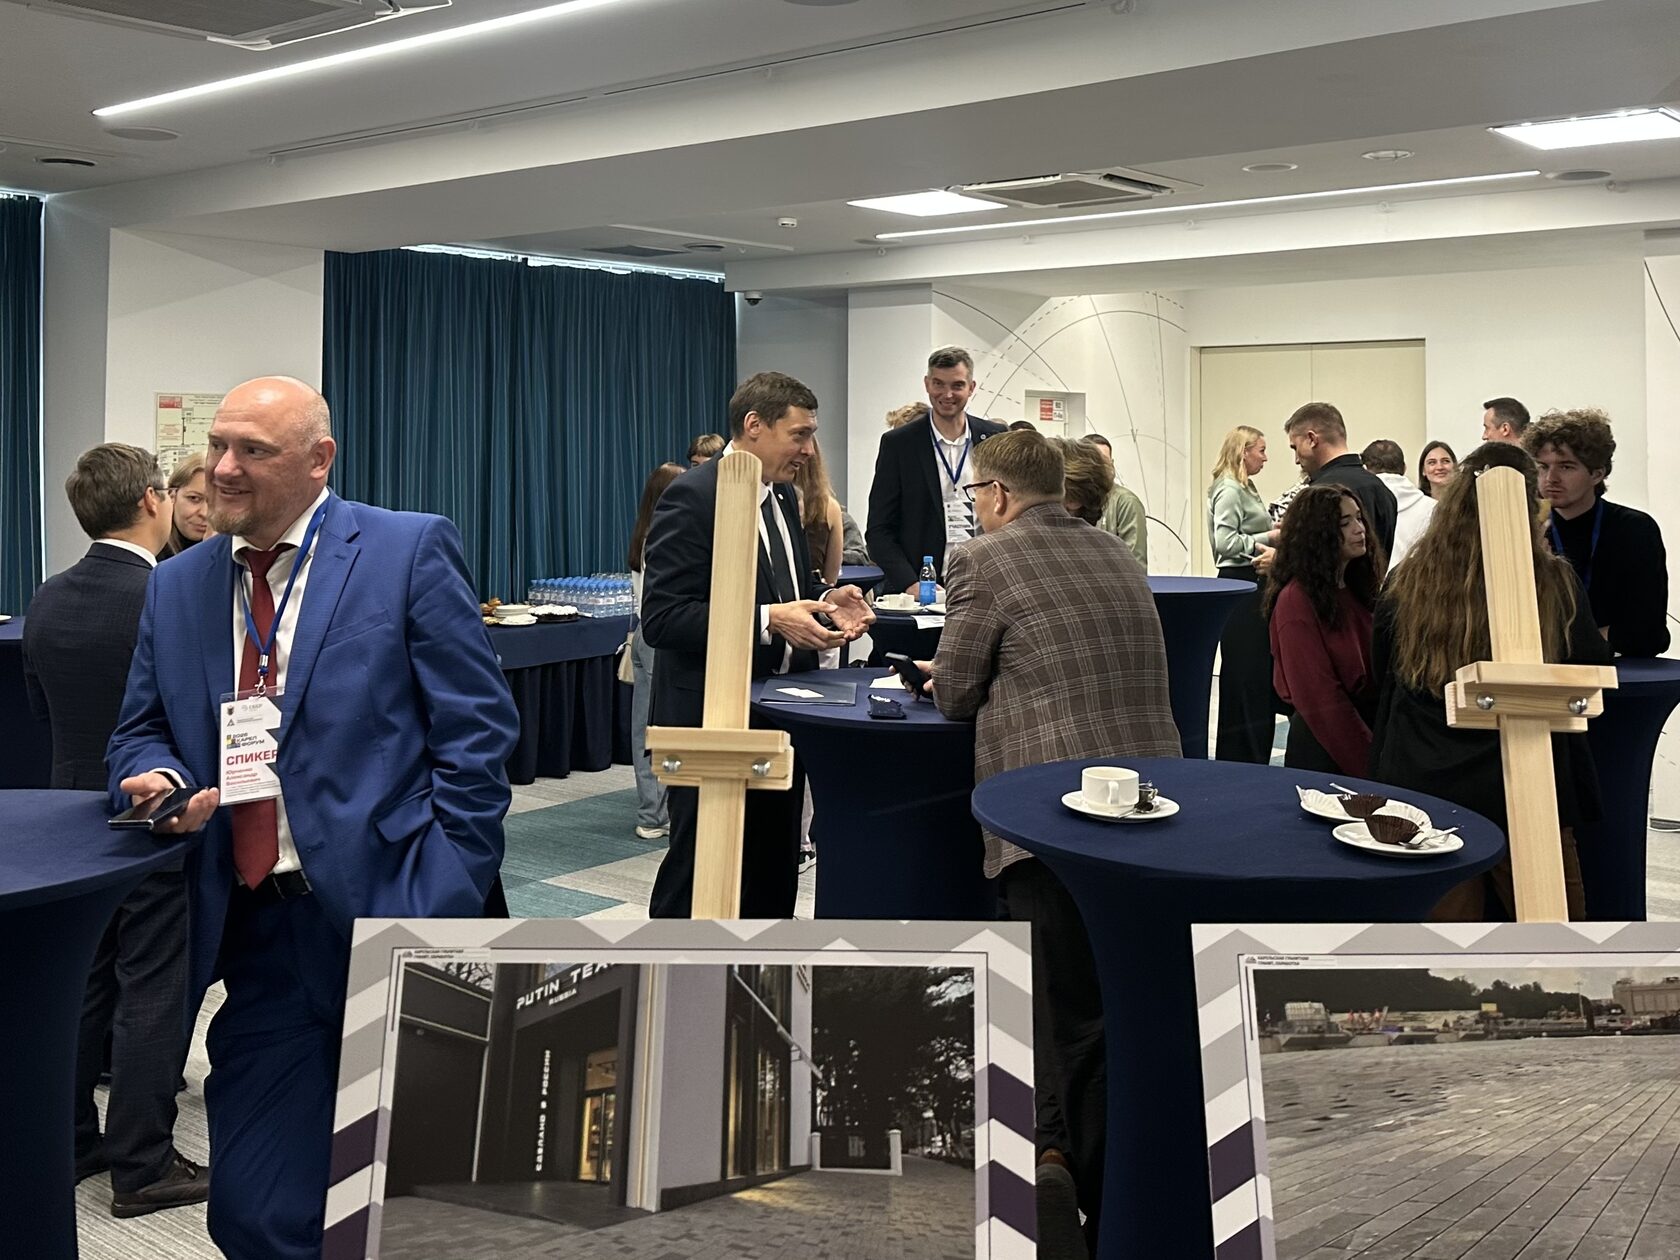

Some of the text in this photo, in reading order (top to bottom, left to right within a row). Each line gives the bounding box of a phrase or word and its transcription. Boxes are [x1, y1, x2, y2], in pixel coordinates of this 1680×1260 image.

[226, 750, 278, 766] СПИКЕР
[516, 963, 615, 1010] PUTIN TEA
[541, 1049, 551, 1096] РОССИИ
